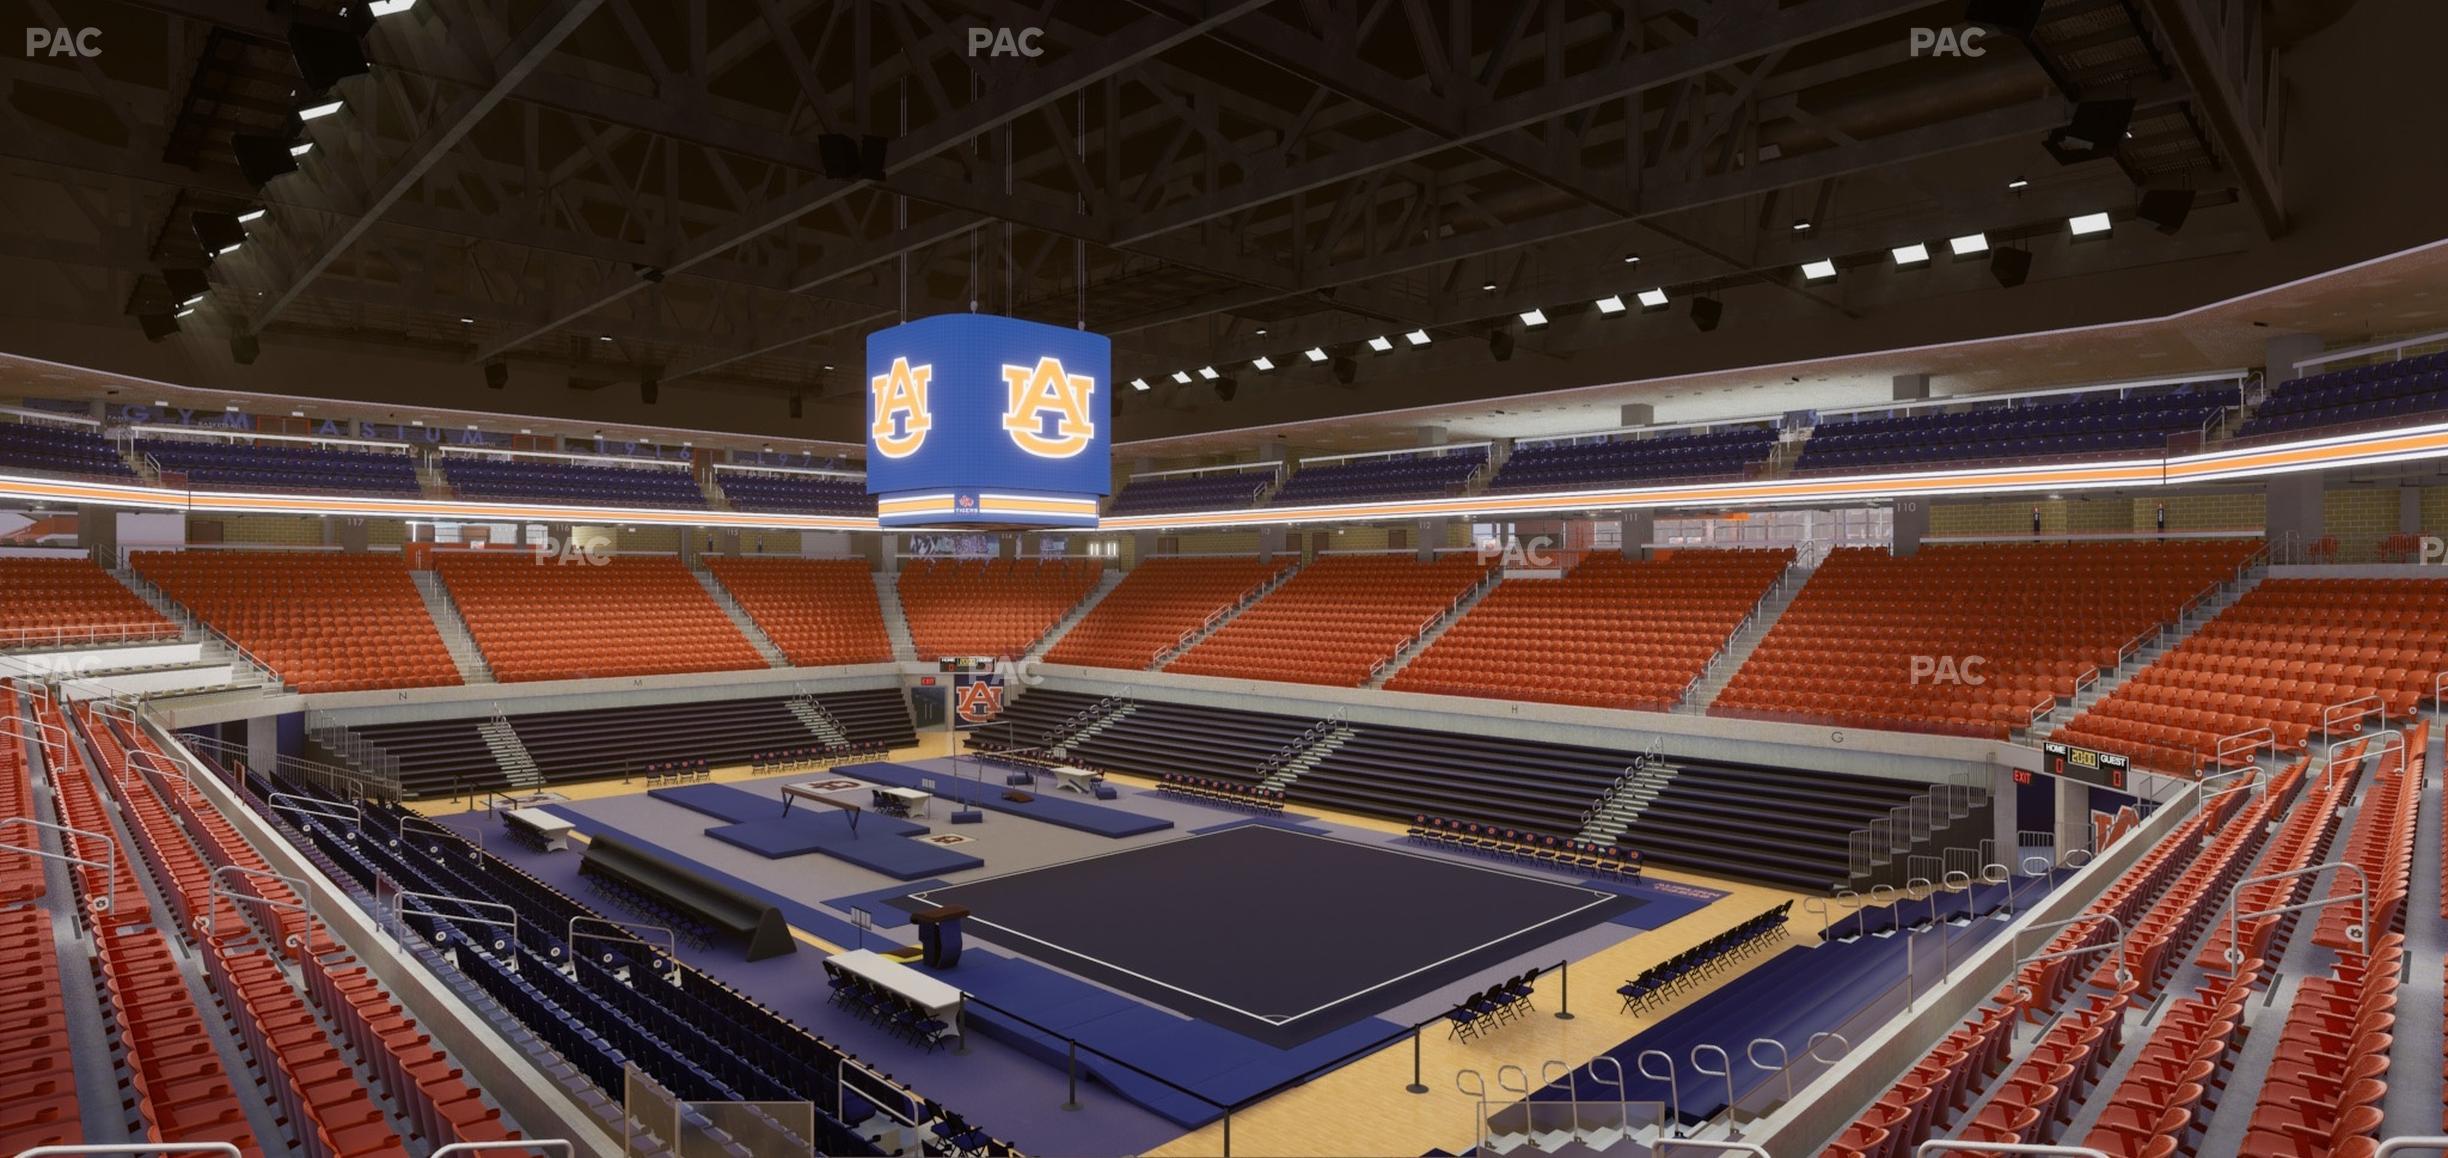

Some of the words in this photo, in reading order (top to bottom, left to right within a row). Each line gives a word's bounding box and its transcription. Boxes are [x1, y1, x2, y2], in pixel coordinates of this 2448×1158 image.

[1897, 502, 1916, 512] 110
[347, 518, 364, 527] 117
[399, 691, 407, 700] N
[1512, 704, 1518, 714] H
[1831, 731, 1843, 744] G
[2046, 743, 2066, 755] HOME
[2071, 749, 2096, 767] 20:00
[2100, 754, 2125, 767] GUEST
[2014, 769, 2032, 785] EXIT
